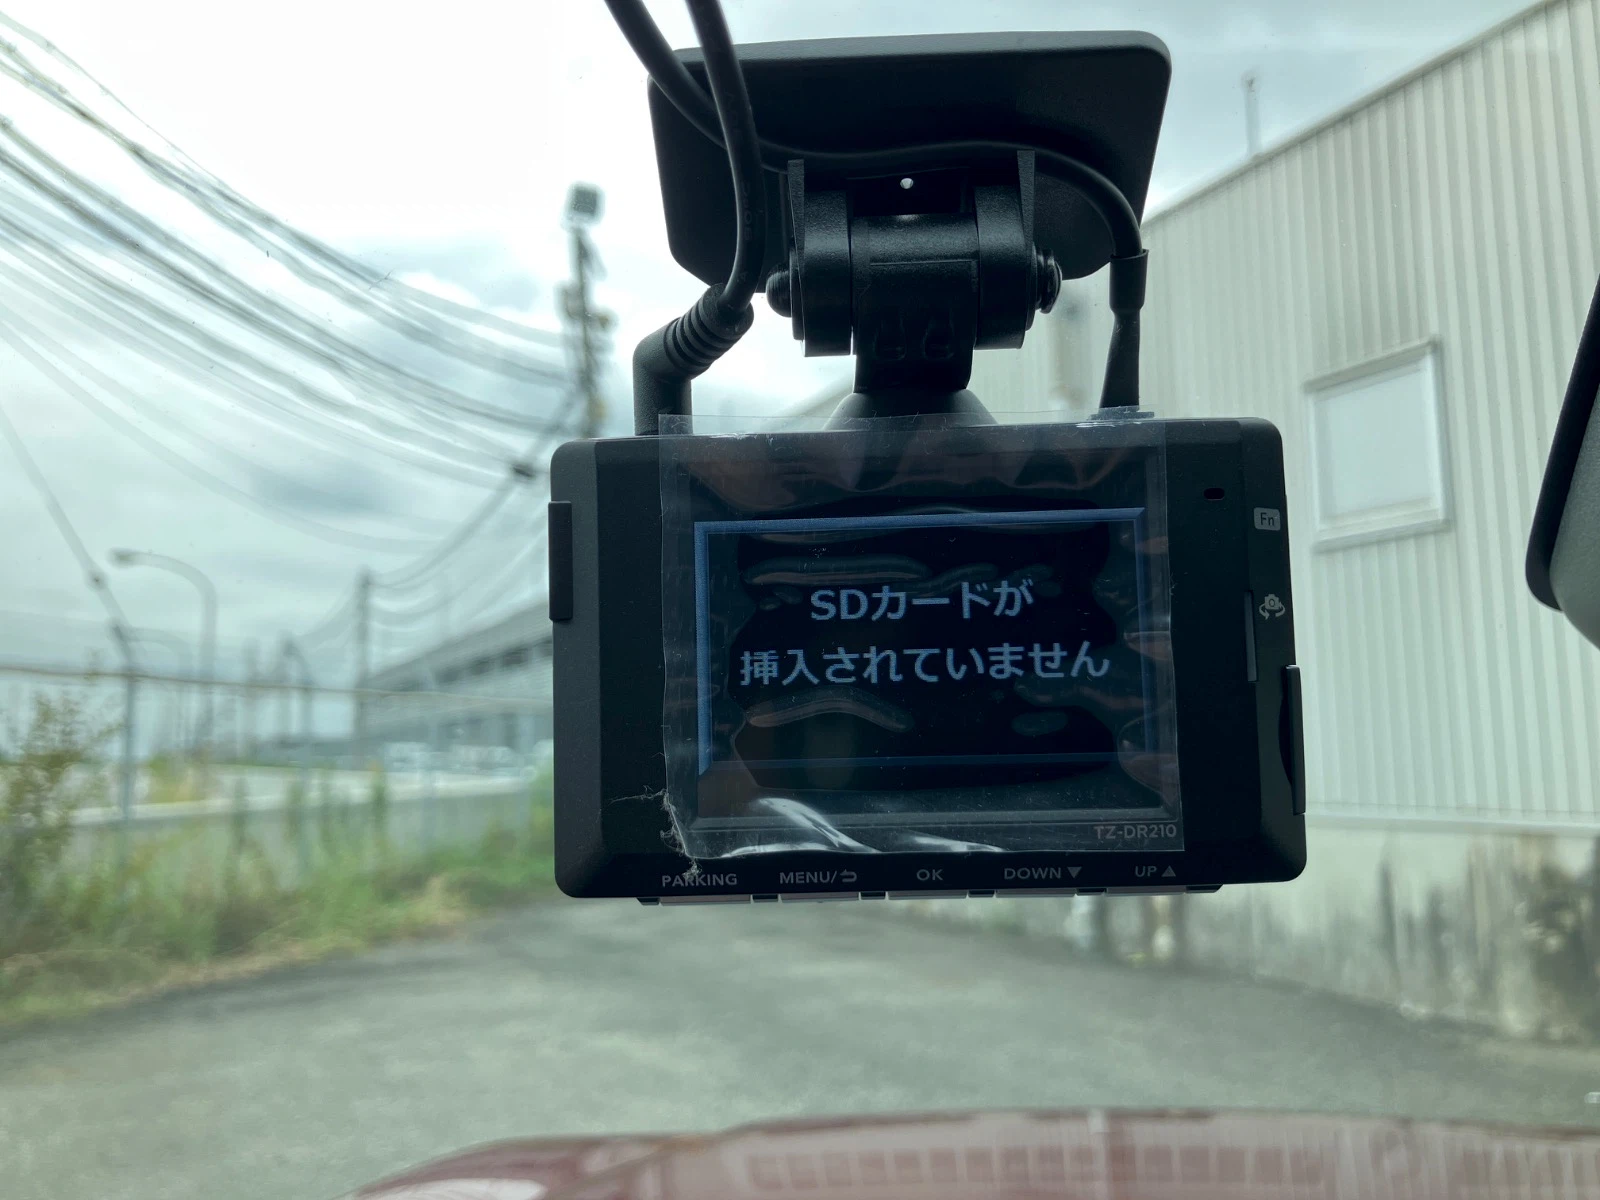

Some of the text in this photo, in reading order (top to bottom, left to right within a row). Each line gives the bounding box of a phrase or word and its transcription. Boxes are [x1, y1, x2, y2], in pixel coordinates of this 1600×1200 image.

[810, 579, 1035, 621] SDカードが
[740, 640, 1111, 687] 挿入されていません
[1094, 823, 1177, 840] TZ-DR210
[916, 869, 943, 881] OK
[1004, 867, 1062, 880] DOWN
[1135, 865, 1158, 878] UP
[662, 873, 738, 887] PARKING
